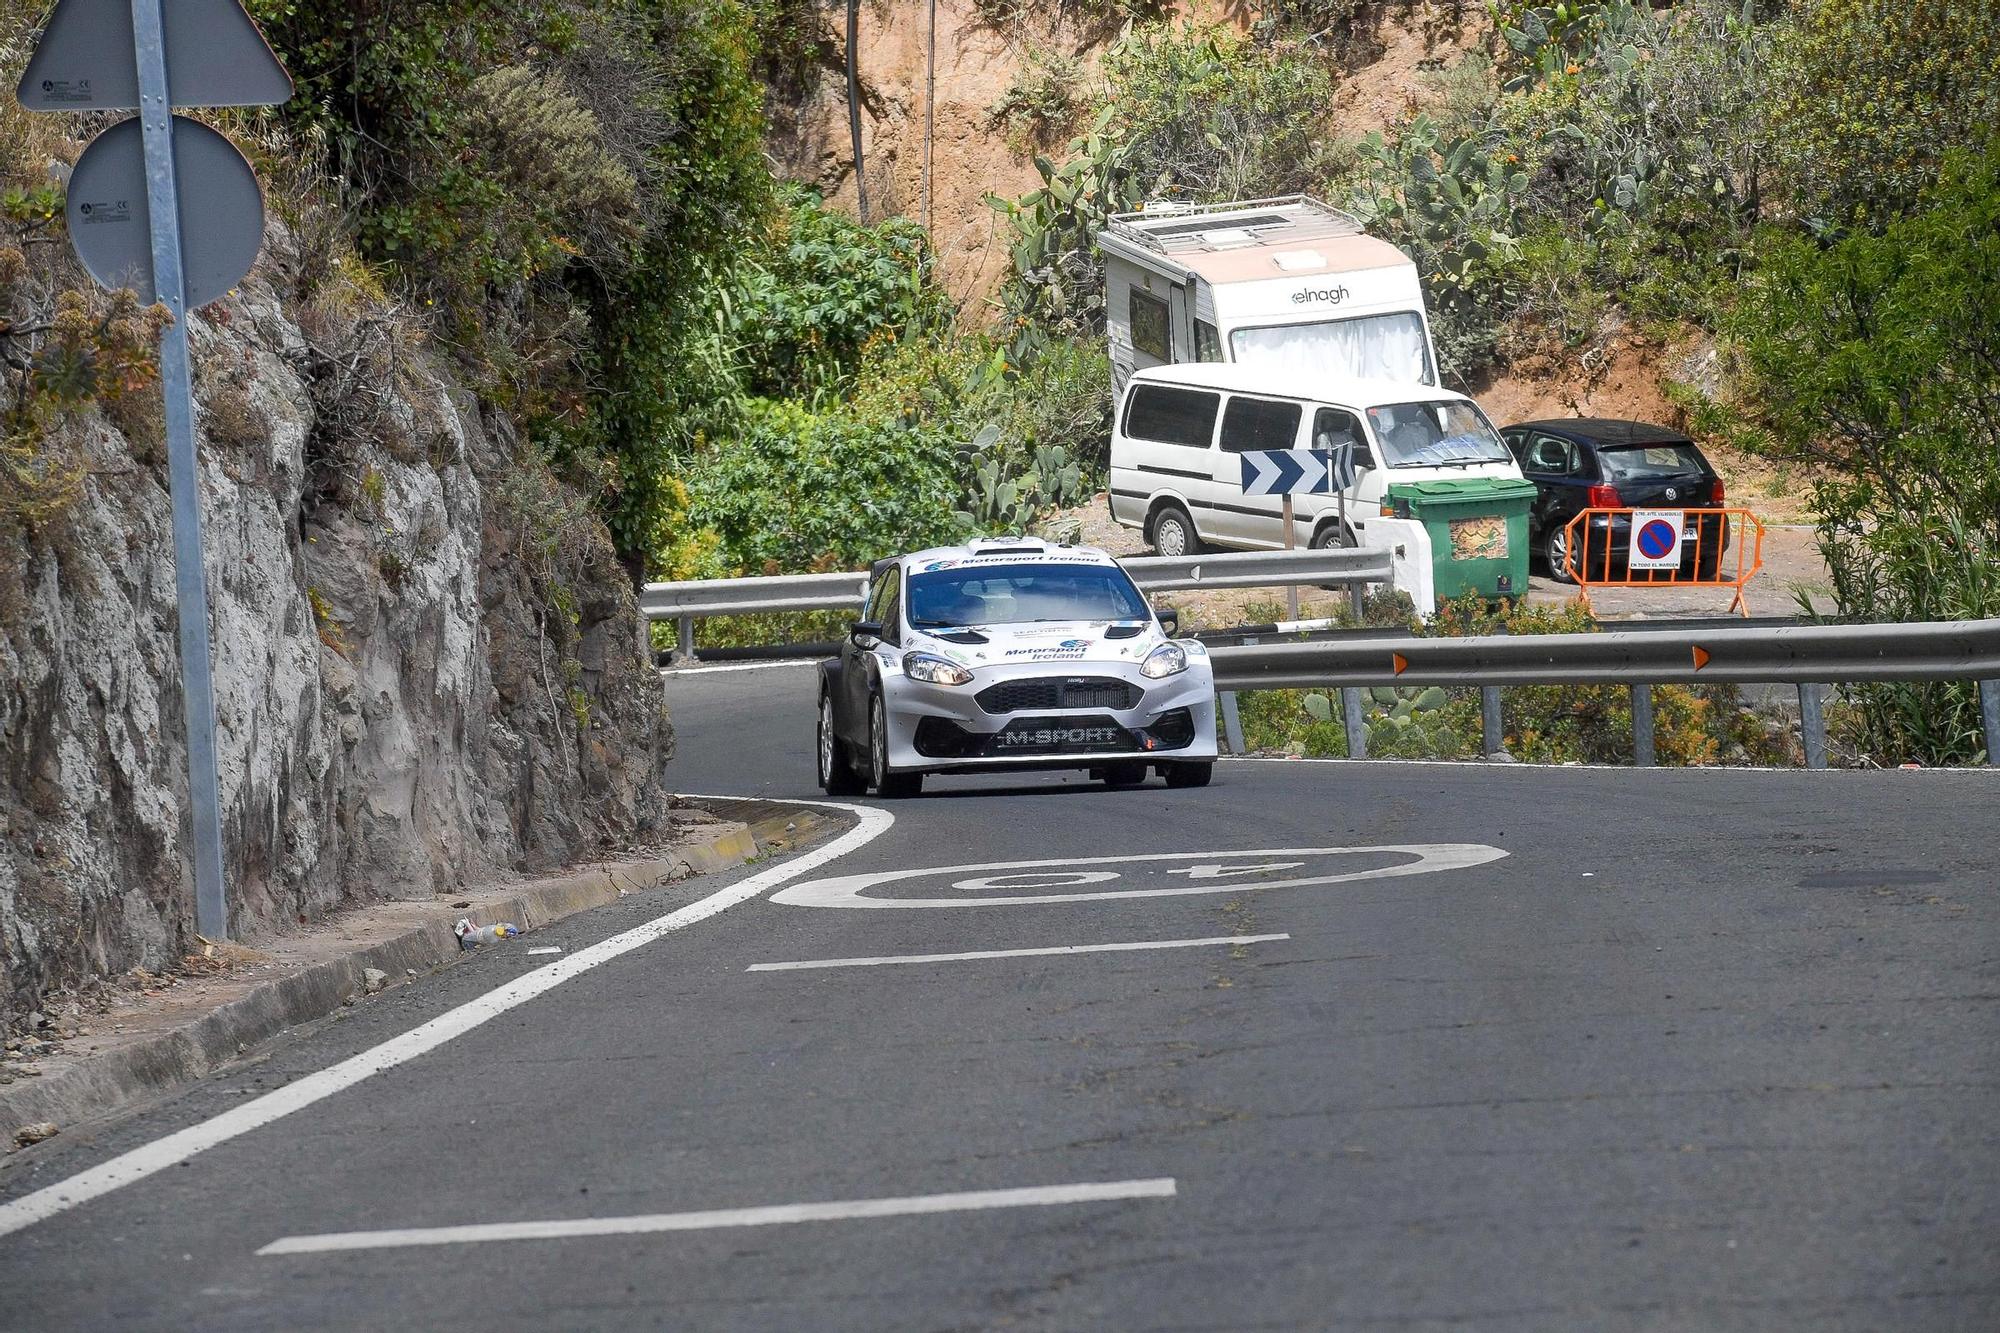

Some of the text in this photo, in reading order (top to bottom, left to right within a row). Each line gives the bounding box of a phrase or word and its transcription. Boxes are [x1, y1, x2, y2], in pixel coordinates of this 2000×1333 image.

[1294, 284, 1350, 305] elnagh
[961, 556, 1045, 565] Motorsport
[1005, 647, 1088, 656] Motorsport
[1006, 727, 1118, 745] M-SPORT
